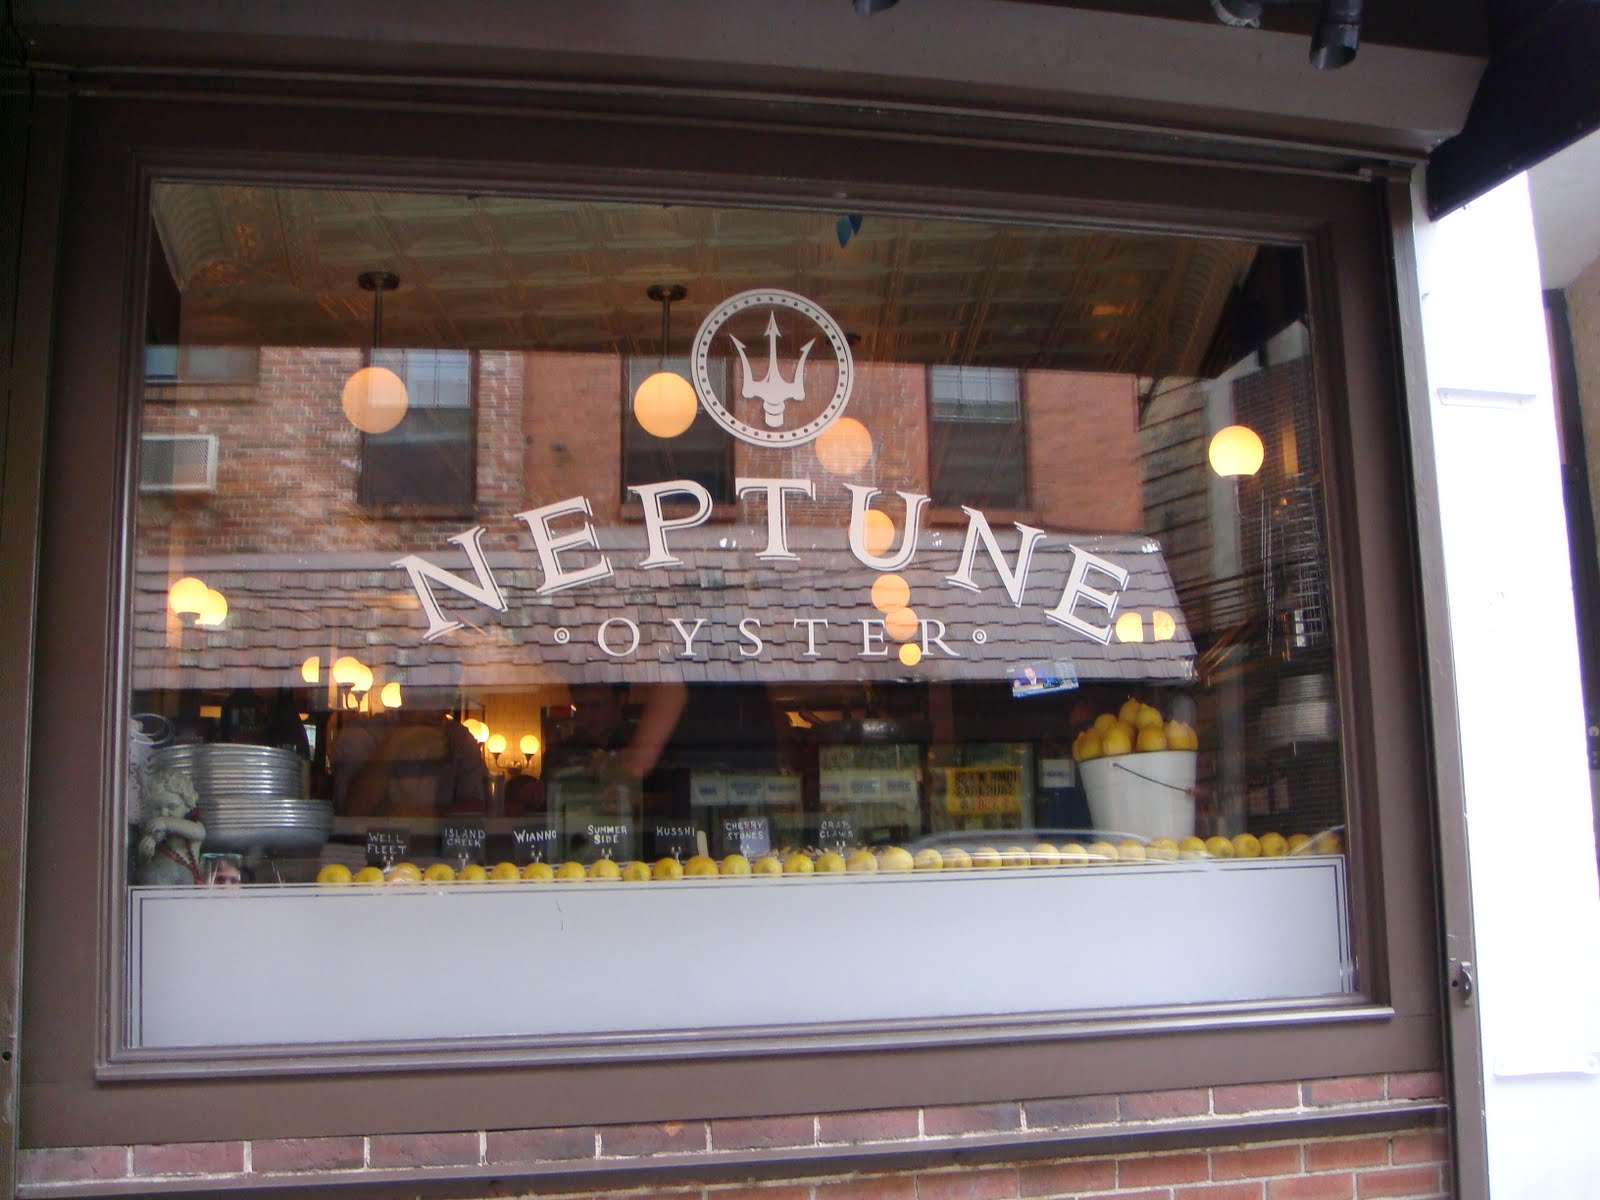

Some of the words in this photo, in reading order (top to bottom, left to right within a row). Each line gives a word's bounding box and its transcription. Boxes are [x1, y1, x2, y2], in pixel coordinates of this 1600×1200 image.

[390, 478, 1129, 646] NEPTUNE
[597, 617, 960, 657] OYSTER
[587, 824, 628, 836] SUMMER
[656, 825, 696, 837] KUSSHI
[725, 820, 764, 831] CHERRY
[368, 832, 405, 844] WELL
[444, 827, 486, 839] ISLAND
[513, 829, 557, 844] WIANNO
[726, 830, 764, 841] STONES
[593, 834, 620, 845] SIDE
[367, 844, 407, 855] FLEET
